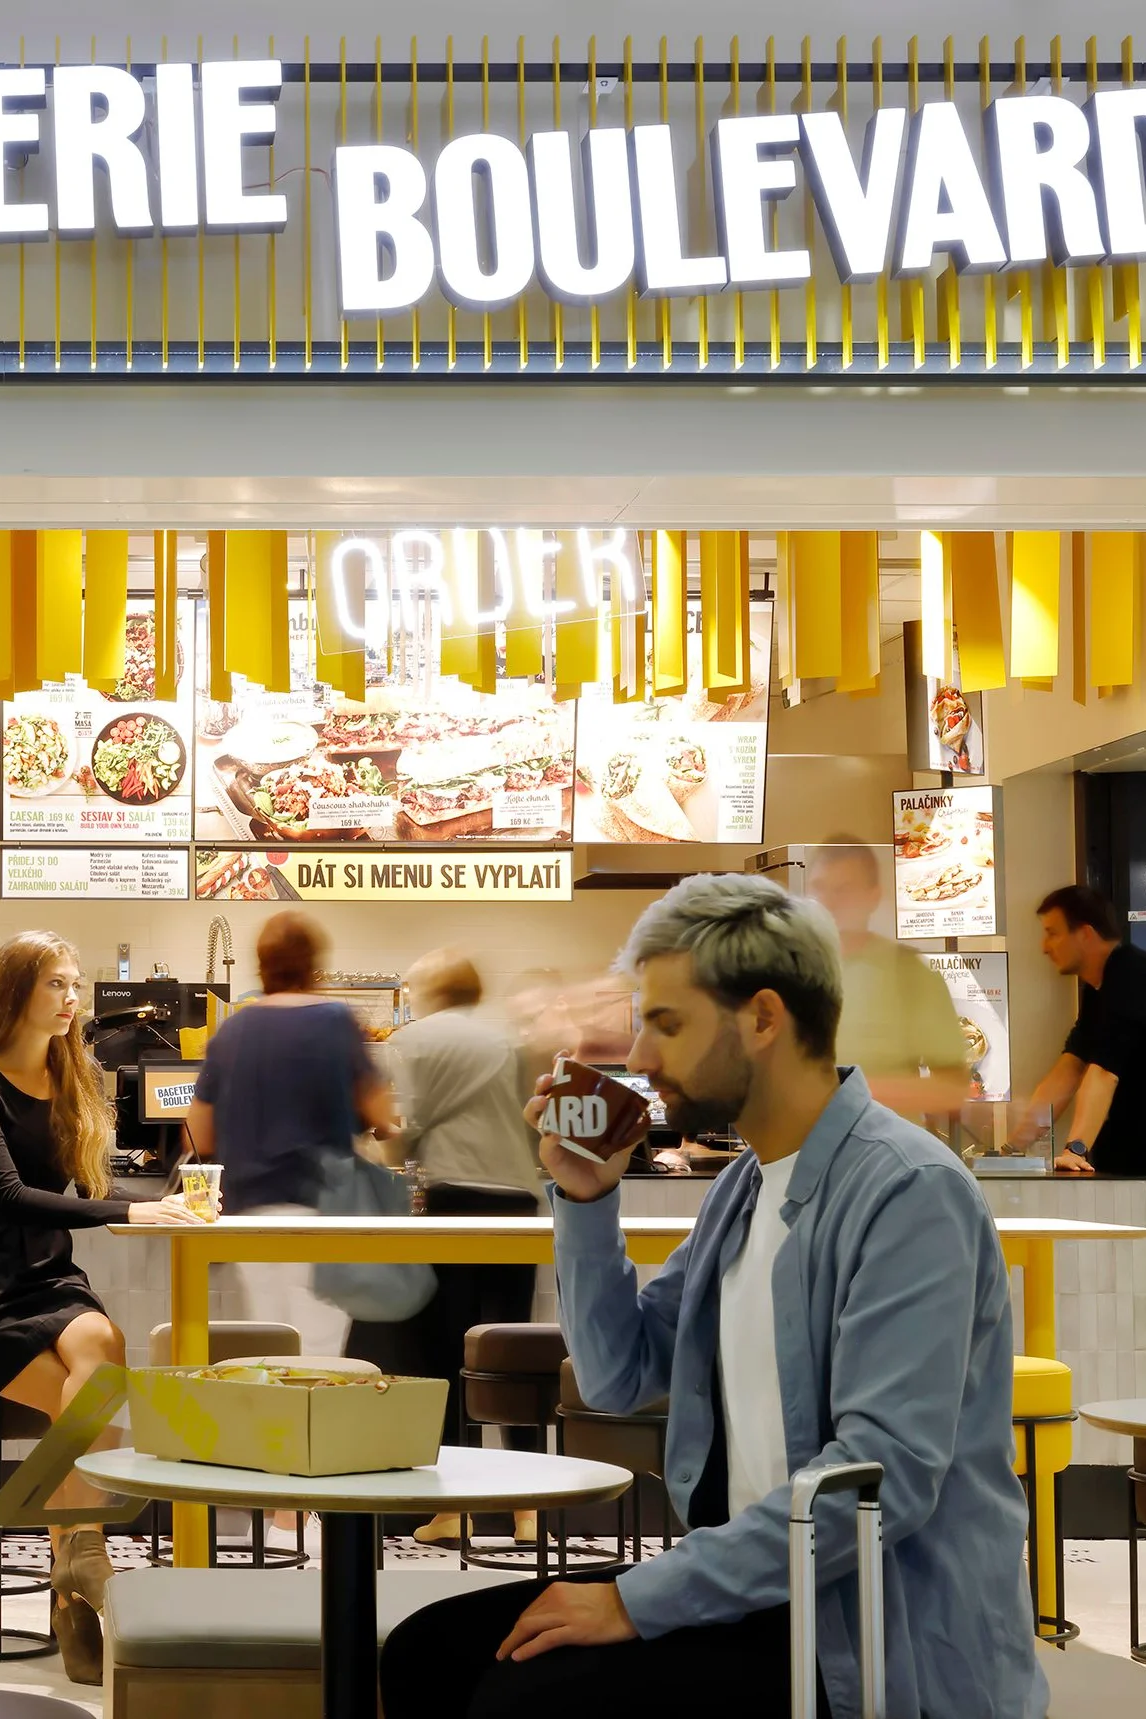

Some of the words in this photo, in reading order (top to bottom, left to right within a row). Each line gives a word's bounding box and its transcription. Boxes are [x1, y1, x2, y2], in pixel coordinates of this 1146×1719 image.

[312, 802, 346, 810] Couscous
[349, 799, 390, 809] shakshuka
[900, 794, 954, 811] PALAČINKY
[10, 811, 44, 821] CAESAR
[49, 812, 62, 821] 169
[64, 811, 75, 821] Kč
[80, 811, 114, 822] SESTAV
[116, 811, 125, 822] SI
[128, 809, 156, 822] SALÁT
[510, 818, 522, 826] 169
[523, 817, 531, 825] Kč
[8, 854, 35, 866] PŘIDEJ
[37, 856, 45, 865] SI
[47, 856, 59, 866] DO
[8, 867, 43, 878] VELKÉHO
[298, 859, 336, 888] DÁT
[344, 864, 363, 888] SI
[371, 864, 432, 888] MENU
[441, 864, 466, 888] SE
[474, 860, 561, 889] VYPLATÍ
[8, 879, 57, 891] ZAHRADNÍHO
[59, 879, 89, 891] SALÁTU
[177, 887, 184, 895] Kč
[929, 956, 982, 970] PALAČINKY
[158, 1085, 195, 1098] BAGETER
[542, 1095, 608, 1137] ARD
